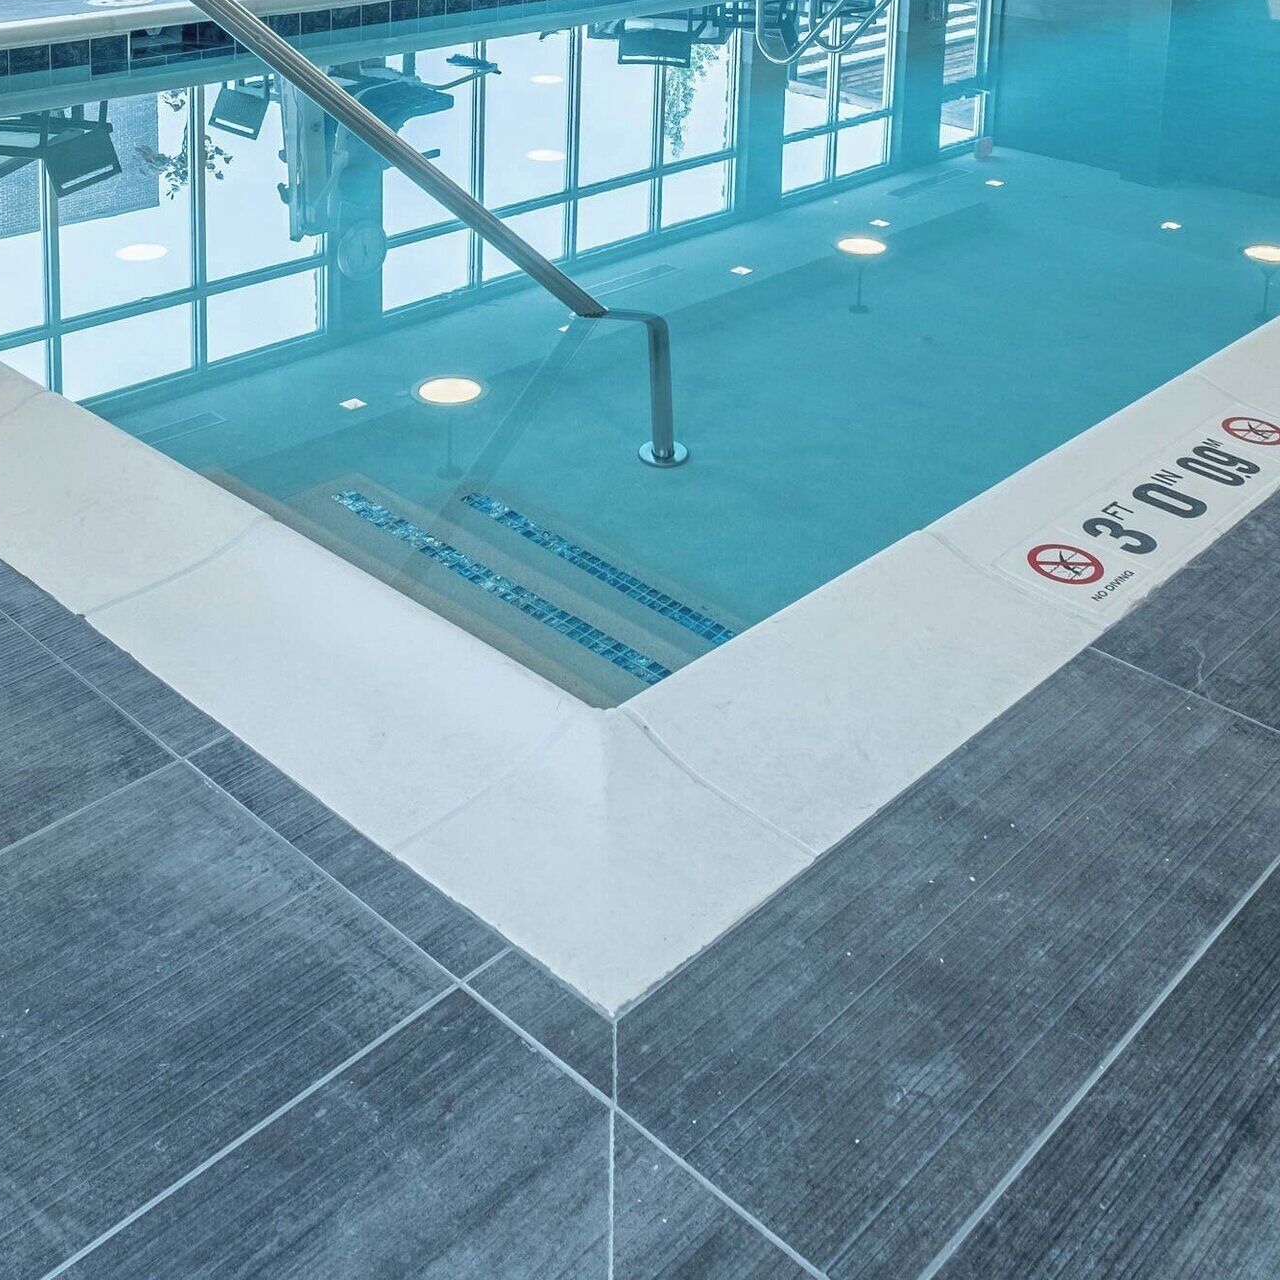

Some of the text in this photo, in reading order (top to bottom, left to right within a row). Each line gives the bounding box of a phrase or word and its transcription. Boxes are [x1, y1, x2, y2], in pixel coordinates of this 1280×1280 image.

[1082, 517, 1157, 555] 3
[1091, 569, 1135, 602] NO DIVING
